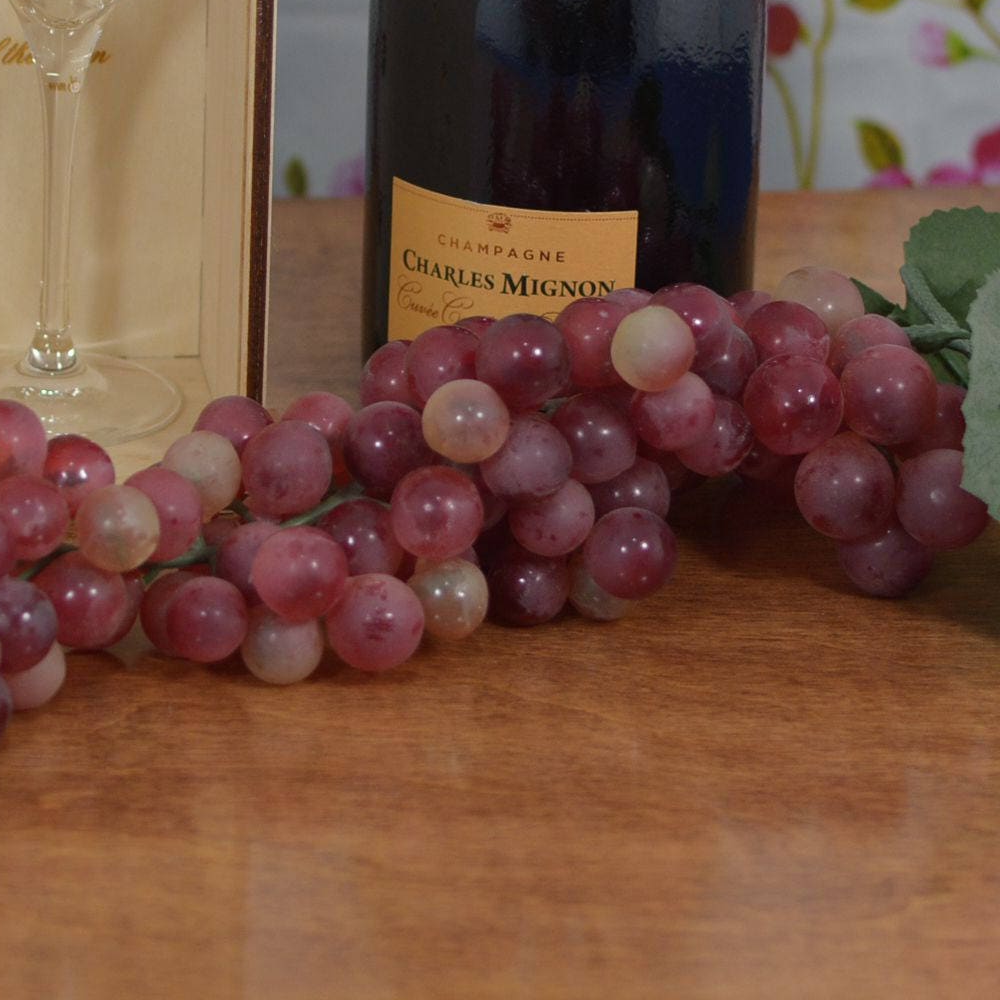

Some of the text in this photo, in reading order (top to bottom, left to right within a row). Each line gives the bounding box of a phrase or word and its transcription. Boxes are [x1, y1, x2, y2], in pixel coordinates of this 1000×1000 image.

[437, 233, 567, 264] CHAMPAGNE
[402, 248, 617, 298] CHARLES MIGNON
